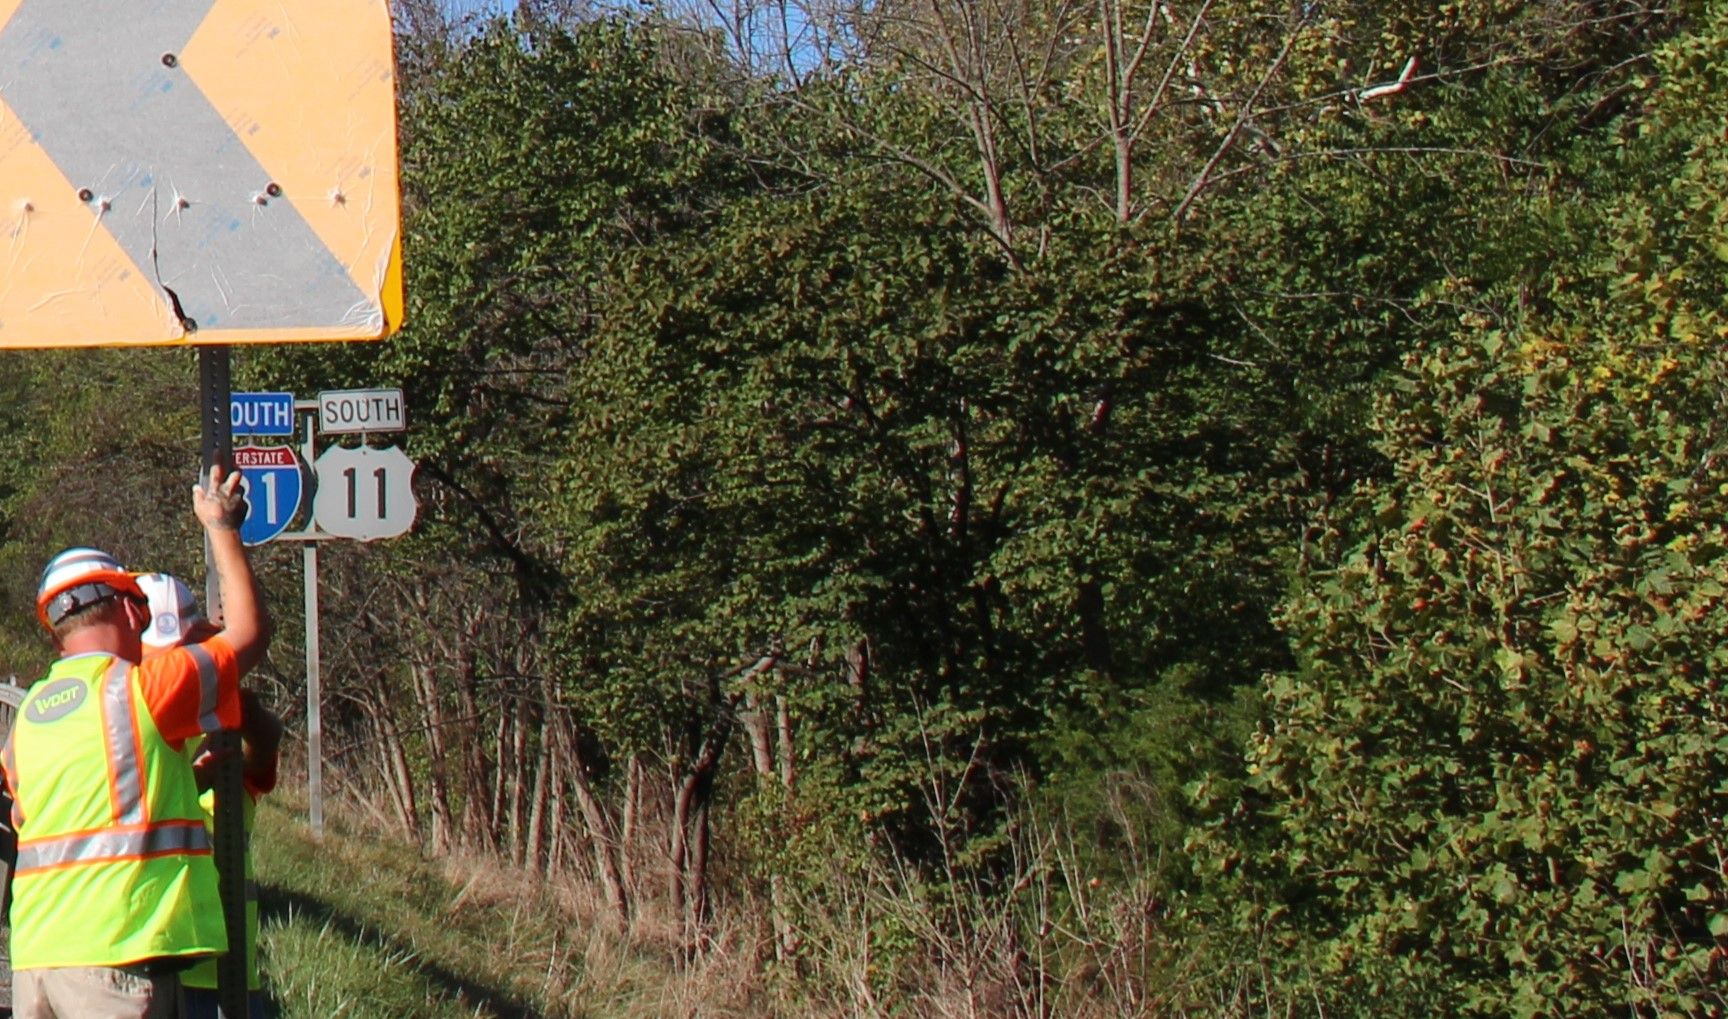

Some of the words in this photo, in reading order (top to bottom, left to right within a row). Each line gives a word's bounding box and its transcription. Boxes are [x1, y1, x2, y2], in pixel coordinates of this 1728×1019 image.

[231, 402, 288, 426] OUTH
[325, 398, 399, 424] SOUTH
[235, 452, 285, 465] ERSTATE
[343, 467, 386, 518] 11
